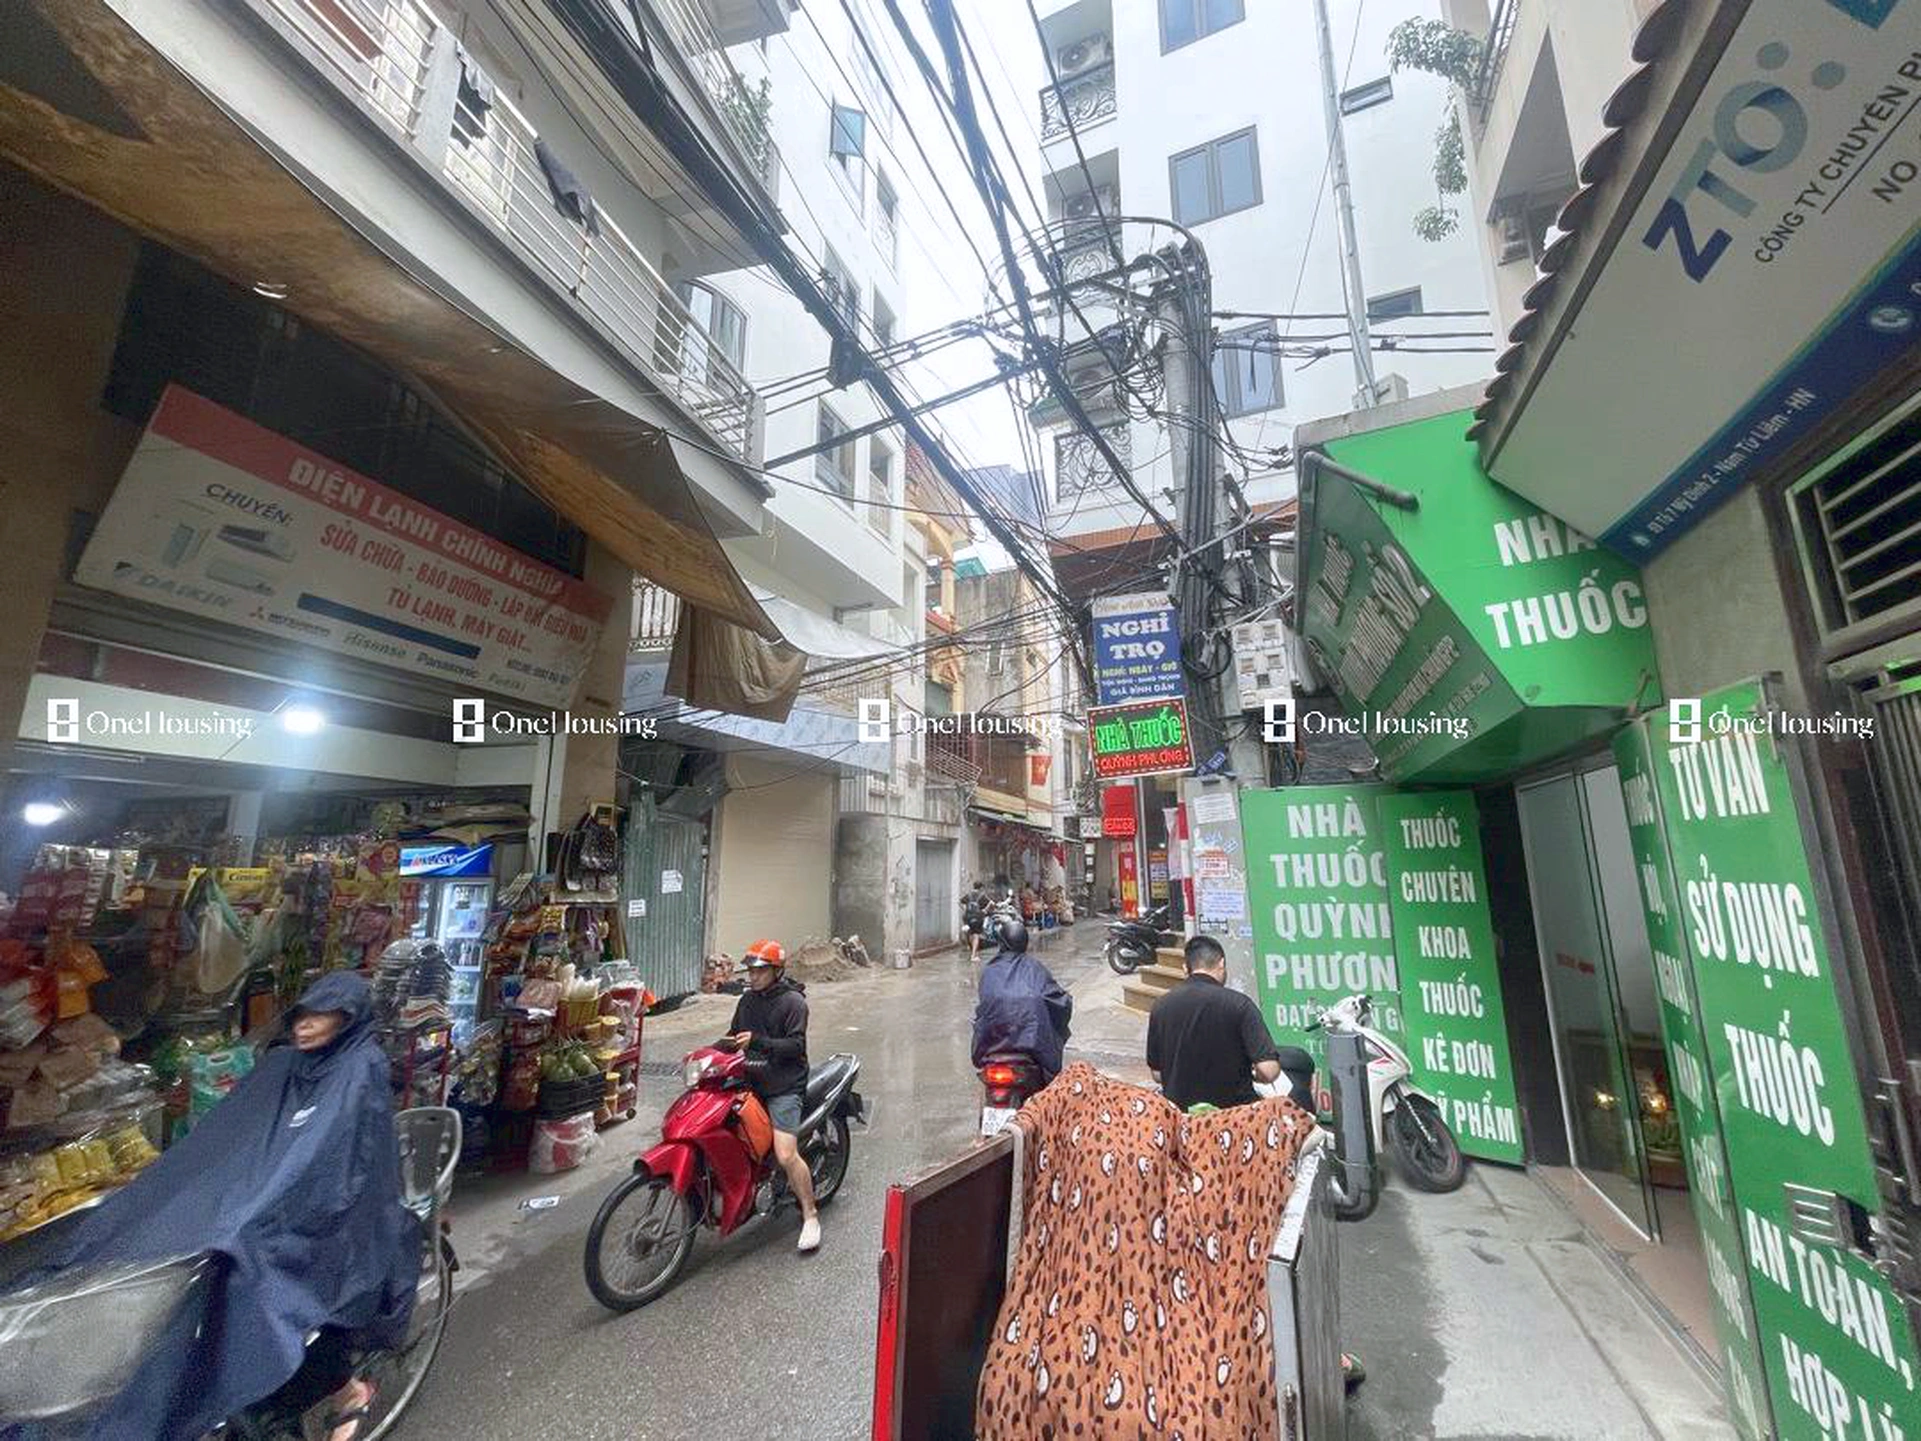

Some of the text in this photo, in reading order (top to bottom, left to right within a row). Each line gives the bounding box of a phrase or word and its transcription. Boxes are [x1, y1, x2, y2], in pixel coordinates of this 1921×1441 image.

[1642, 81, 1807, 284] ZTO
[1754, 211, 1805, 263] CÔNG
[1794, 180, 1826, 209] TY
[1819, 85, 1910, 180] CHUYÊN
[1872, 160, 1918, 203] NO
[288, 457, 367, 507] ĐIỆN
[368, 494, 440, 542] LẠNH
[1101, 611, 1171, 639] NGHỈ
[1485, 569, 1648, 649] THUỐC
[1109, 640, 1166, 660] TRỌ
[1130, 706, 1183, 749] THUỐC
[1287, 796, 1367, 839] NHÀ
[1401, 806, 1462, 849] THUỐC
[1401, 865, 1478, 904] CHUYÊN
[1418, 924, 1473, 961] KHOA
[1687, 853, 1728, 962] SỬ
[1722, 881, 1821, 990] DỤNG
[1265, 950, 1398, 993] PHƯƠN
[1419, 971, 1485, 1019] THUỐC
[1422, 1030, 1497, 1079] KÊ ĐƠN
[1723, 1009, 1836, 1147] THUỐC
[1452, 1089, 1519, 1145] PHẨM
[1746, 1207, 1792, 1293] AN
